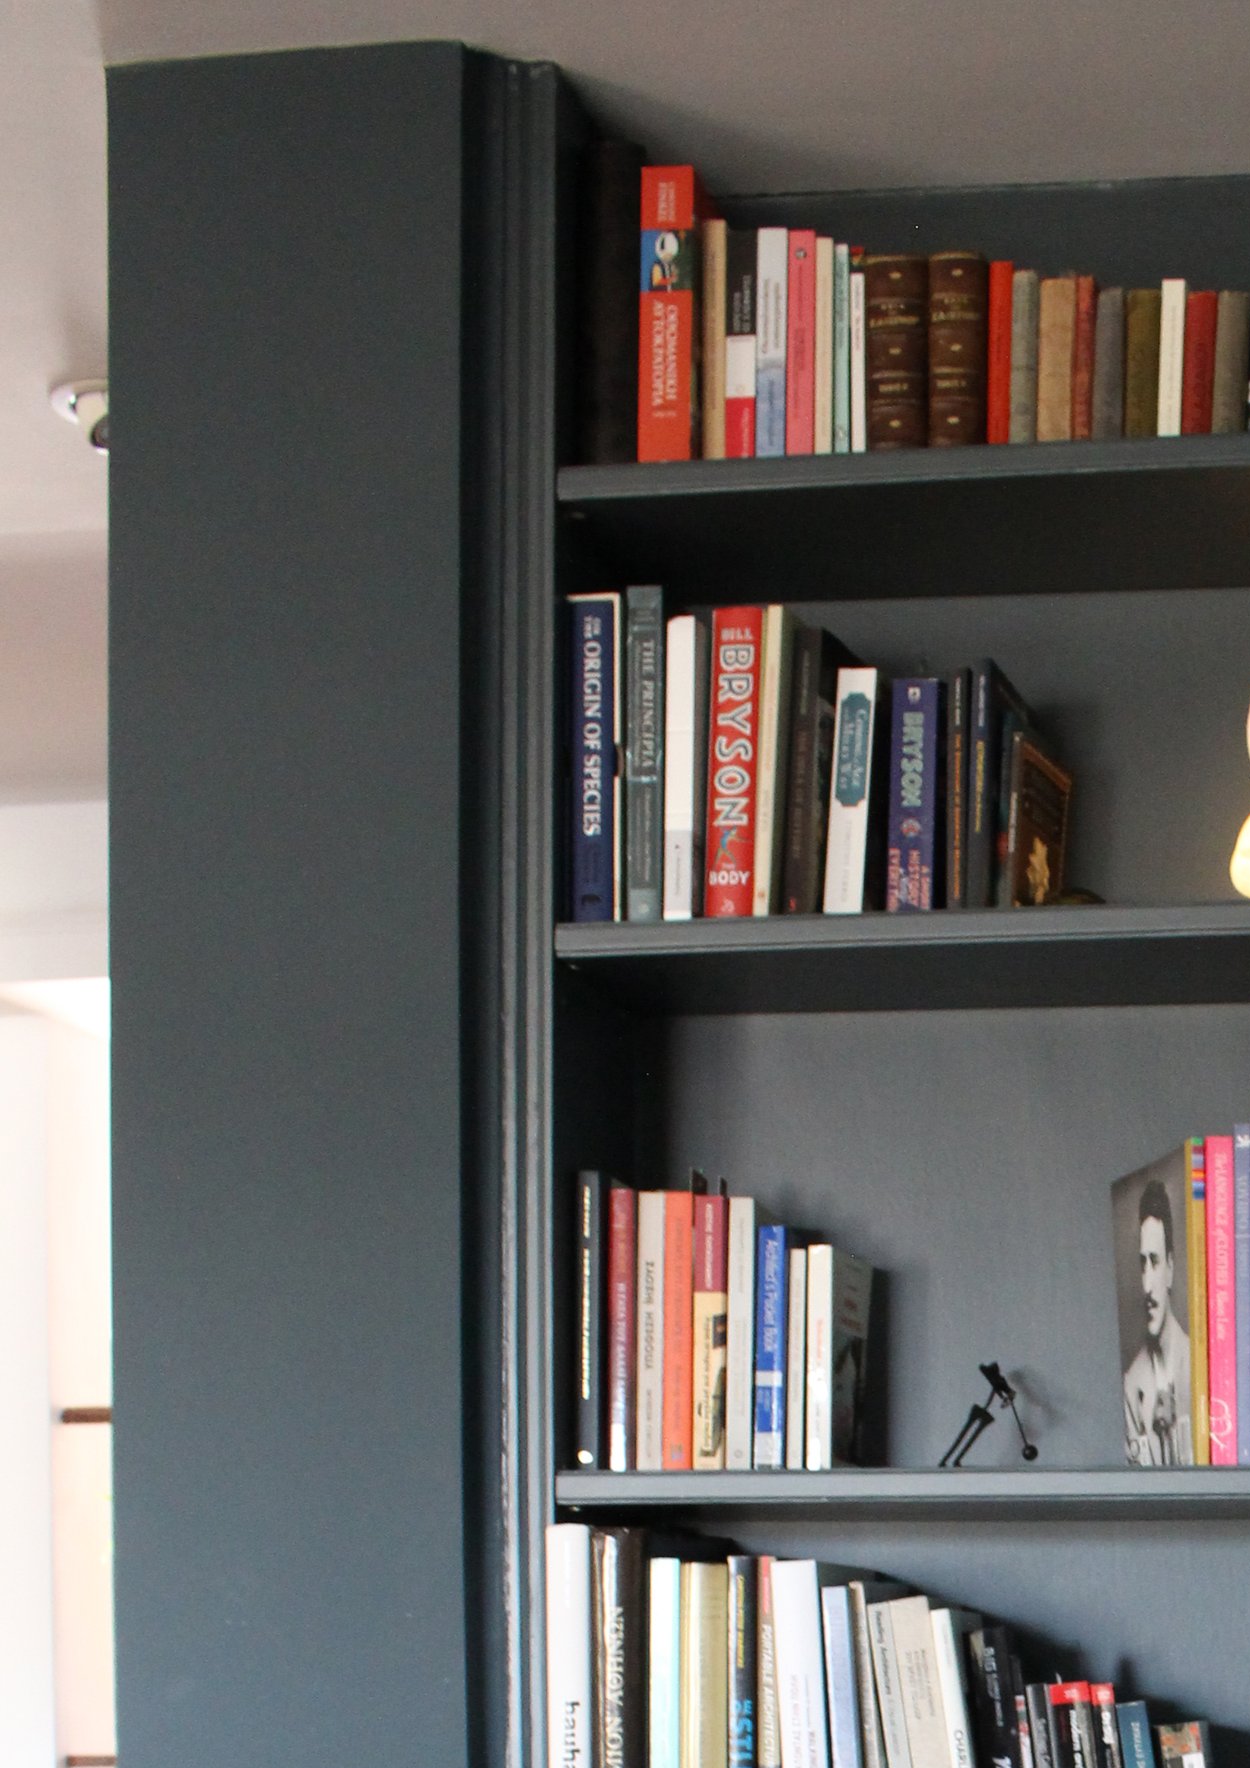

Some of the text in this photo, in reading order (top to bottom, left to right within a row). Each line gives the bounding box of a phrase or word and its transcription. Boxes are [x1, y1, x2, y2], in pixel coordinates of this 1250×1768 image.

[642, 640, 655, 675] THE
[583, 641, 601, 837] ORIGIN OF SPECIES
[641, 680, 655, 767] PRINCIPIA
[713, 644, 754, 827] BRYSON
[901, 712, 925, 807] BRYSON
[708, 870, 749, 887] BODY
[908, 849, 920, 906] HISTORY
[763, 1239, 778, 1354] Architect's Pocket Book
[604, 1605, 624, 1707] ΑΘΗΝΩΝ
[761, 1623, 774, 1684] PORTABLE
[874, 1611, 893, 1696] Reading Architecture
[1069, 1710, 1082, 1752] modern
